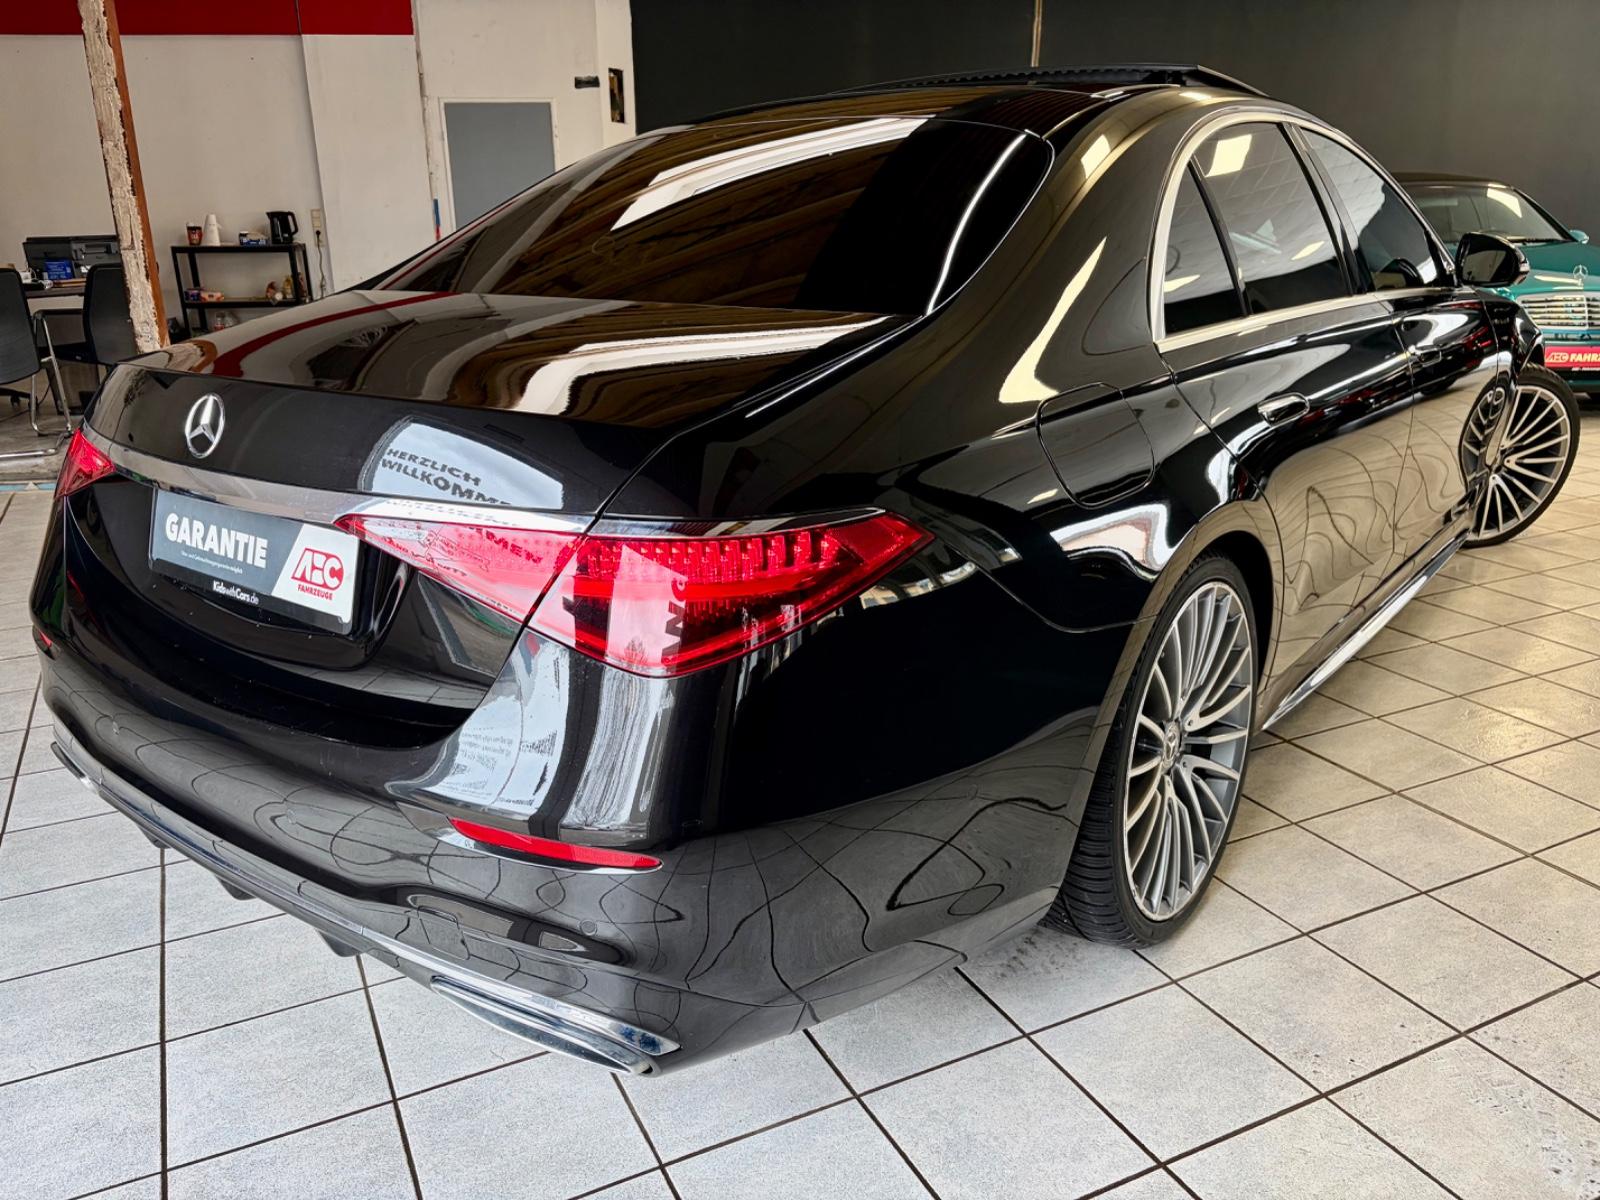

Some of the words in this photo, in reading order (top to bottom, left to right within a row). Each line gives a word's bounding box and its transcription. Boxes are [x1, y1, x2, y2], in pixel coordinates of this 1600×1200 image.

[1570, 353, 1600, 362] FAHR
[387, 448, 481, 487] HERZLICH
[165, 512, 268, 569] GARANTIE
[297, 583, 333, 601] FAHRZEUGE
